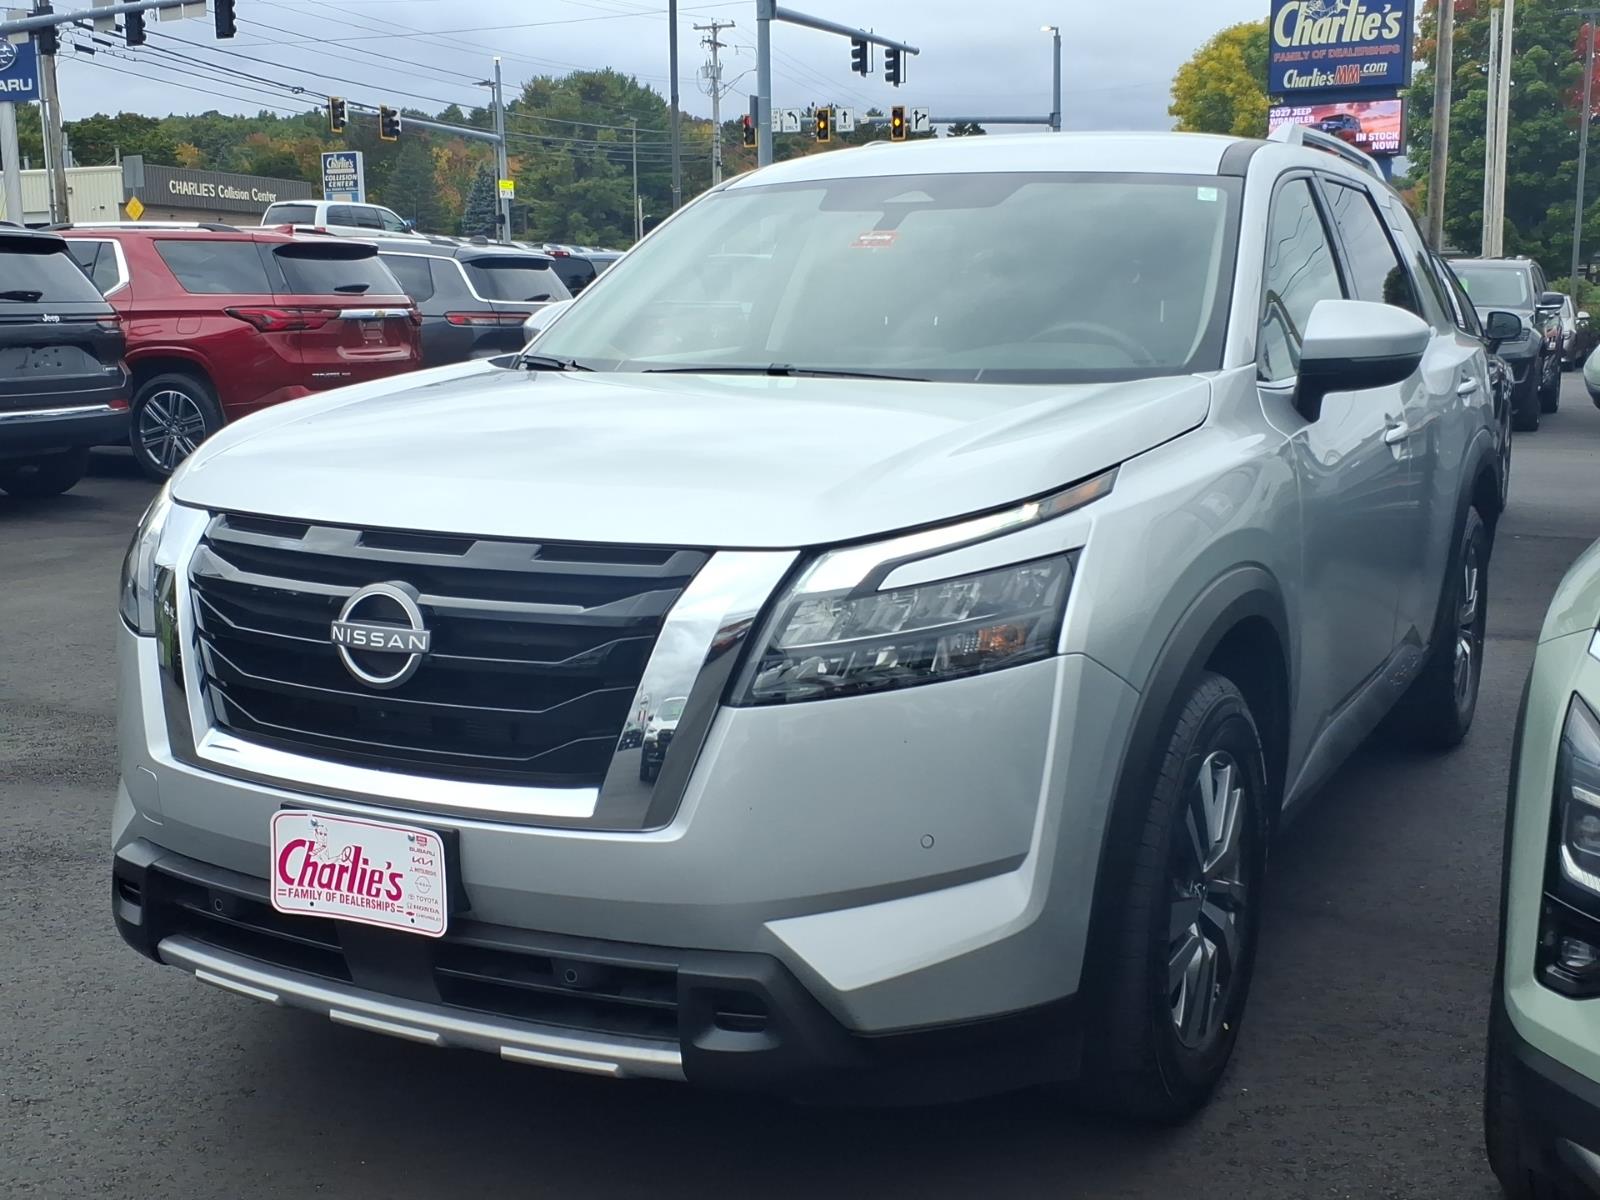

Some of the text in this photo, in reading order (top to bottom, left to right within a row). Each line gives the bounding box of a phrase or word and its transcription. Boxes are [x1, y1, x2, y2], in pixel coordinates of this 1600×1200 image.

[1274, 0, 1403, 47] Charlie's
[1274, 44, 1401, 62] FAMILY OF DEALERSHIPS
[1292, 107, 1312, 116] JEEP
[1270, 116, 1315, 125] WRANGLER
[1356, 131, 1400, 142] IN STOCK
[1372, 140, 1399, 150] NOW!
[325, 174, 358, 182] COLLISION
[328, 180, 354, 188] CENTER
[218, 185, 250, 200] Collision
[251, 187, 277, 202] Center
[42, 313, 60, 323] Jeep
[332, 626, 426, 650] NISSAN
[278, 838, 403, 901] Charlie's
[288, 888, 396, 913] FAMILY OF DEALERSHIPS
[416, 895, 438, 905] TOYOTA
